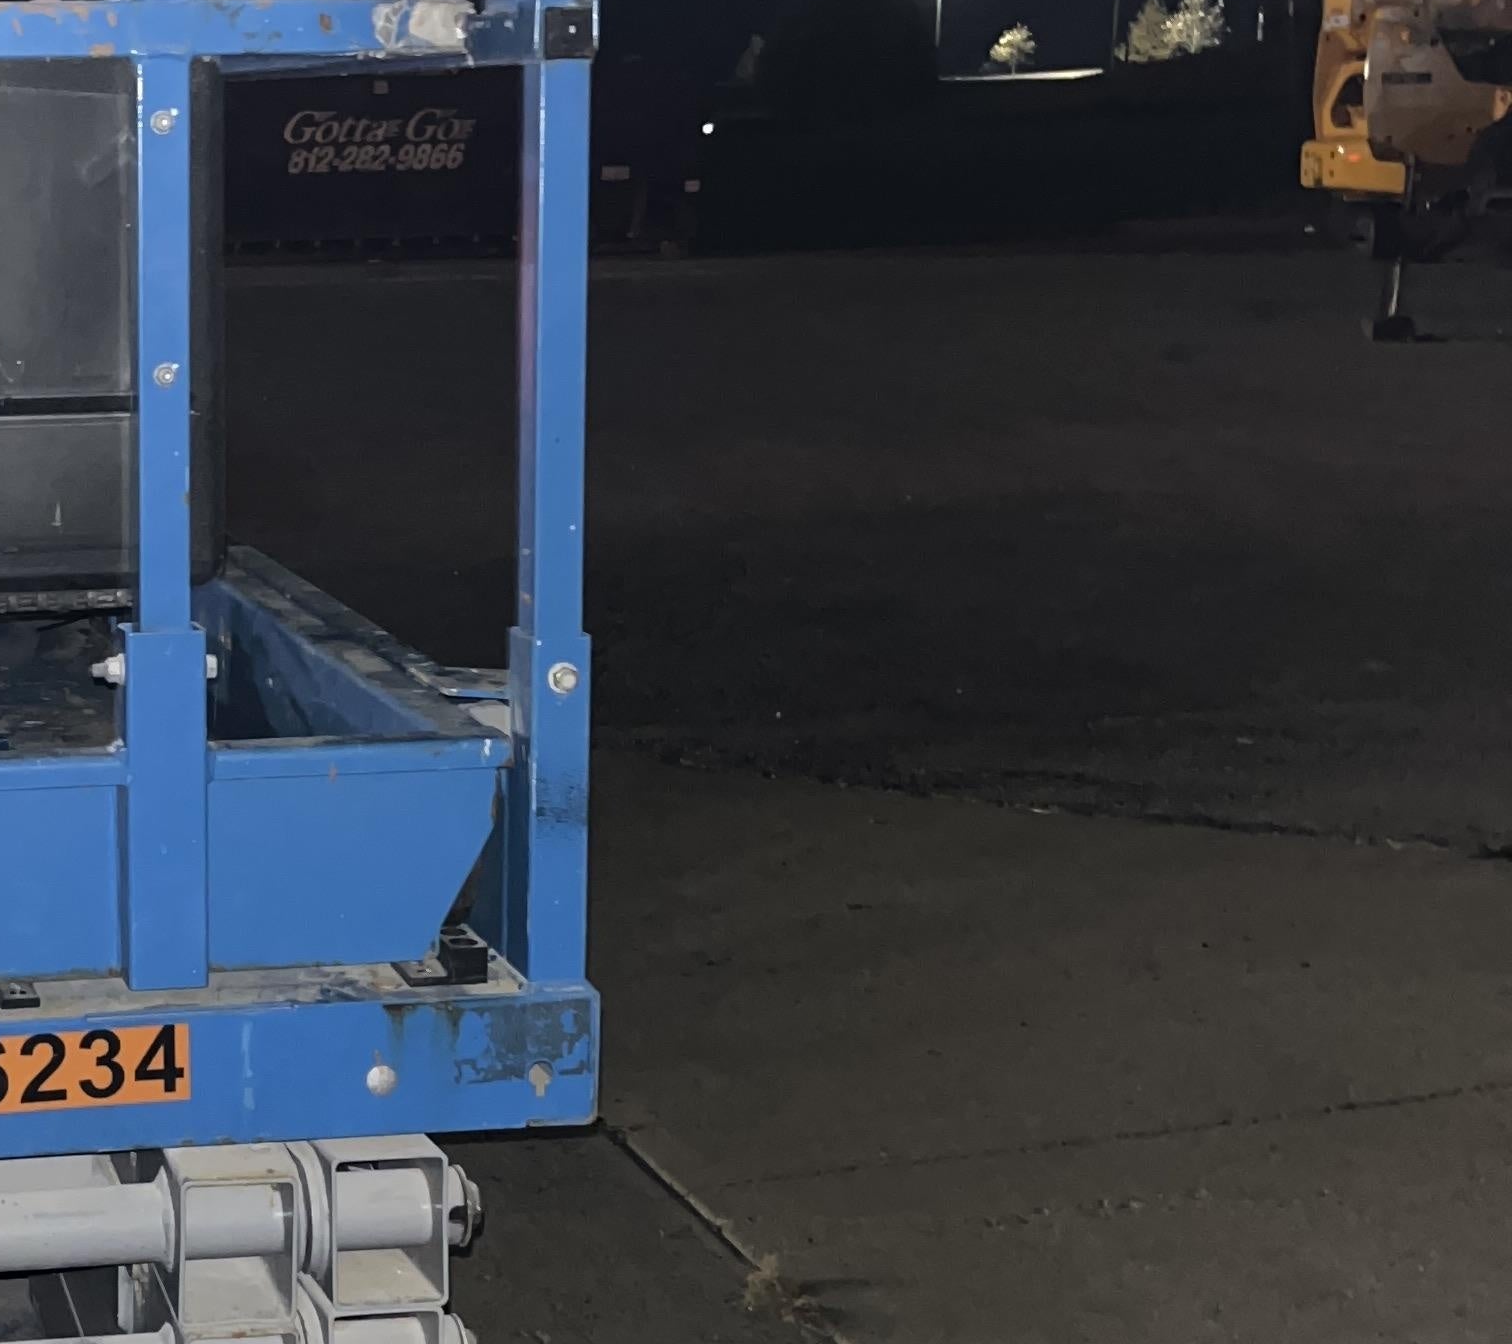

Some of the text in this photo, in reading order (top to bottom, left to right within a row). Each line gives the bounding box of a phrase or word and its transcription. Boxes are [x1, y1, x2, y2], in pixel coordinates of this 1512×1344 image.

[283, 108, 473, 144] Gotta Go
[287, 143, 465, 174] 812-282-9866
